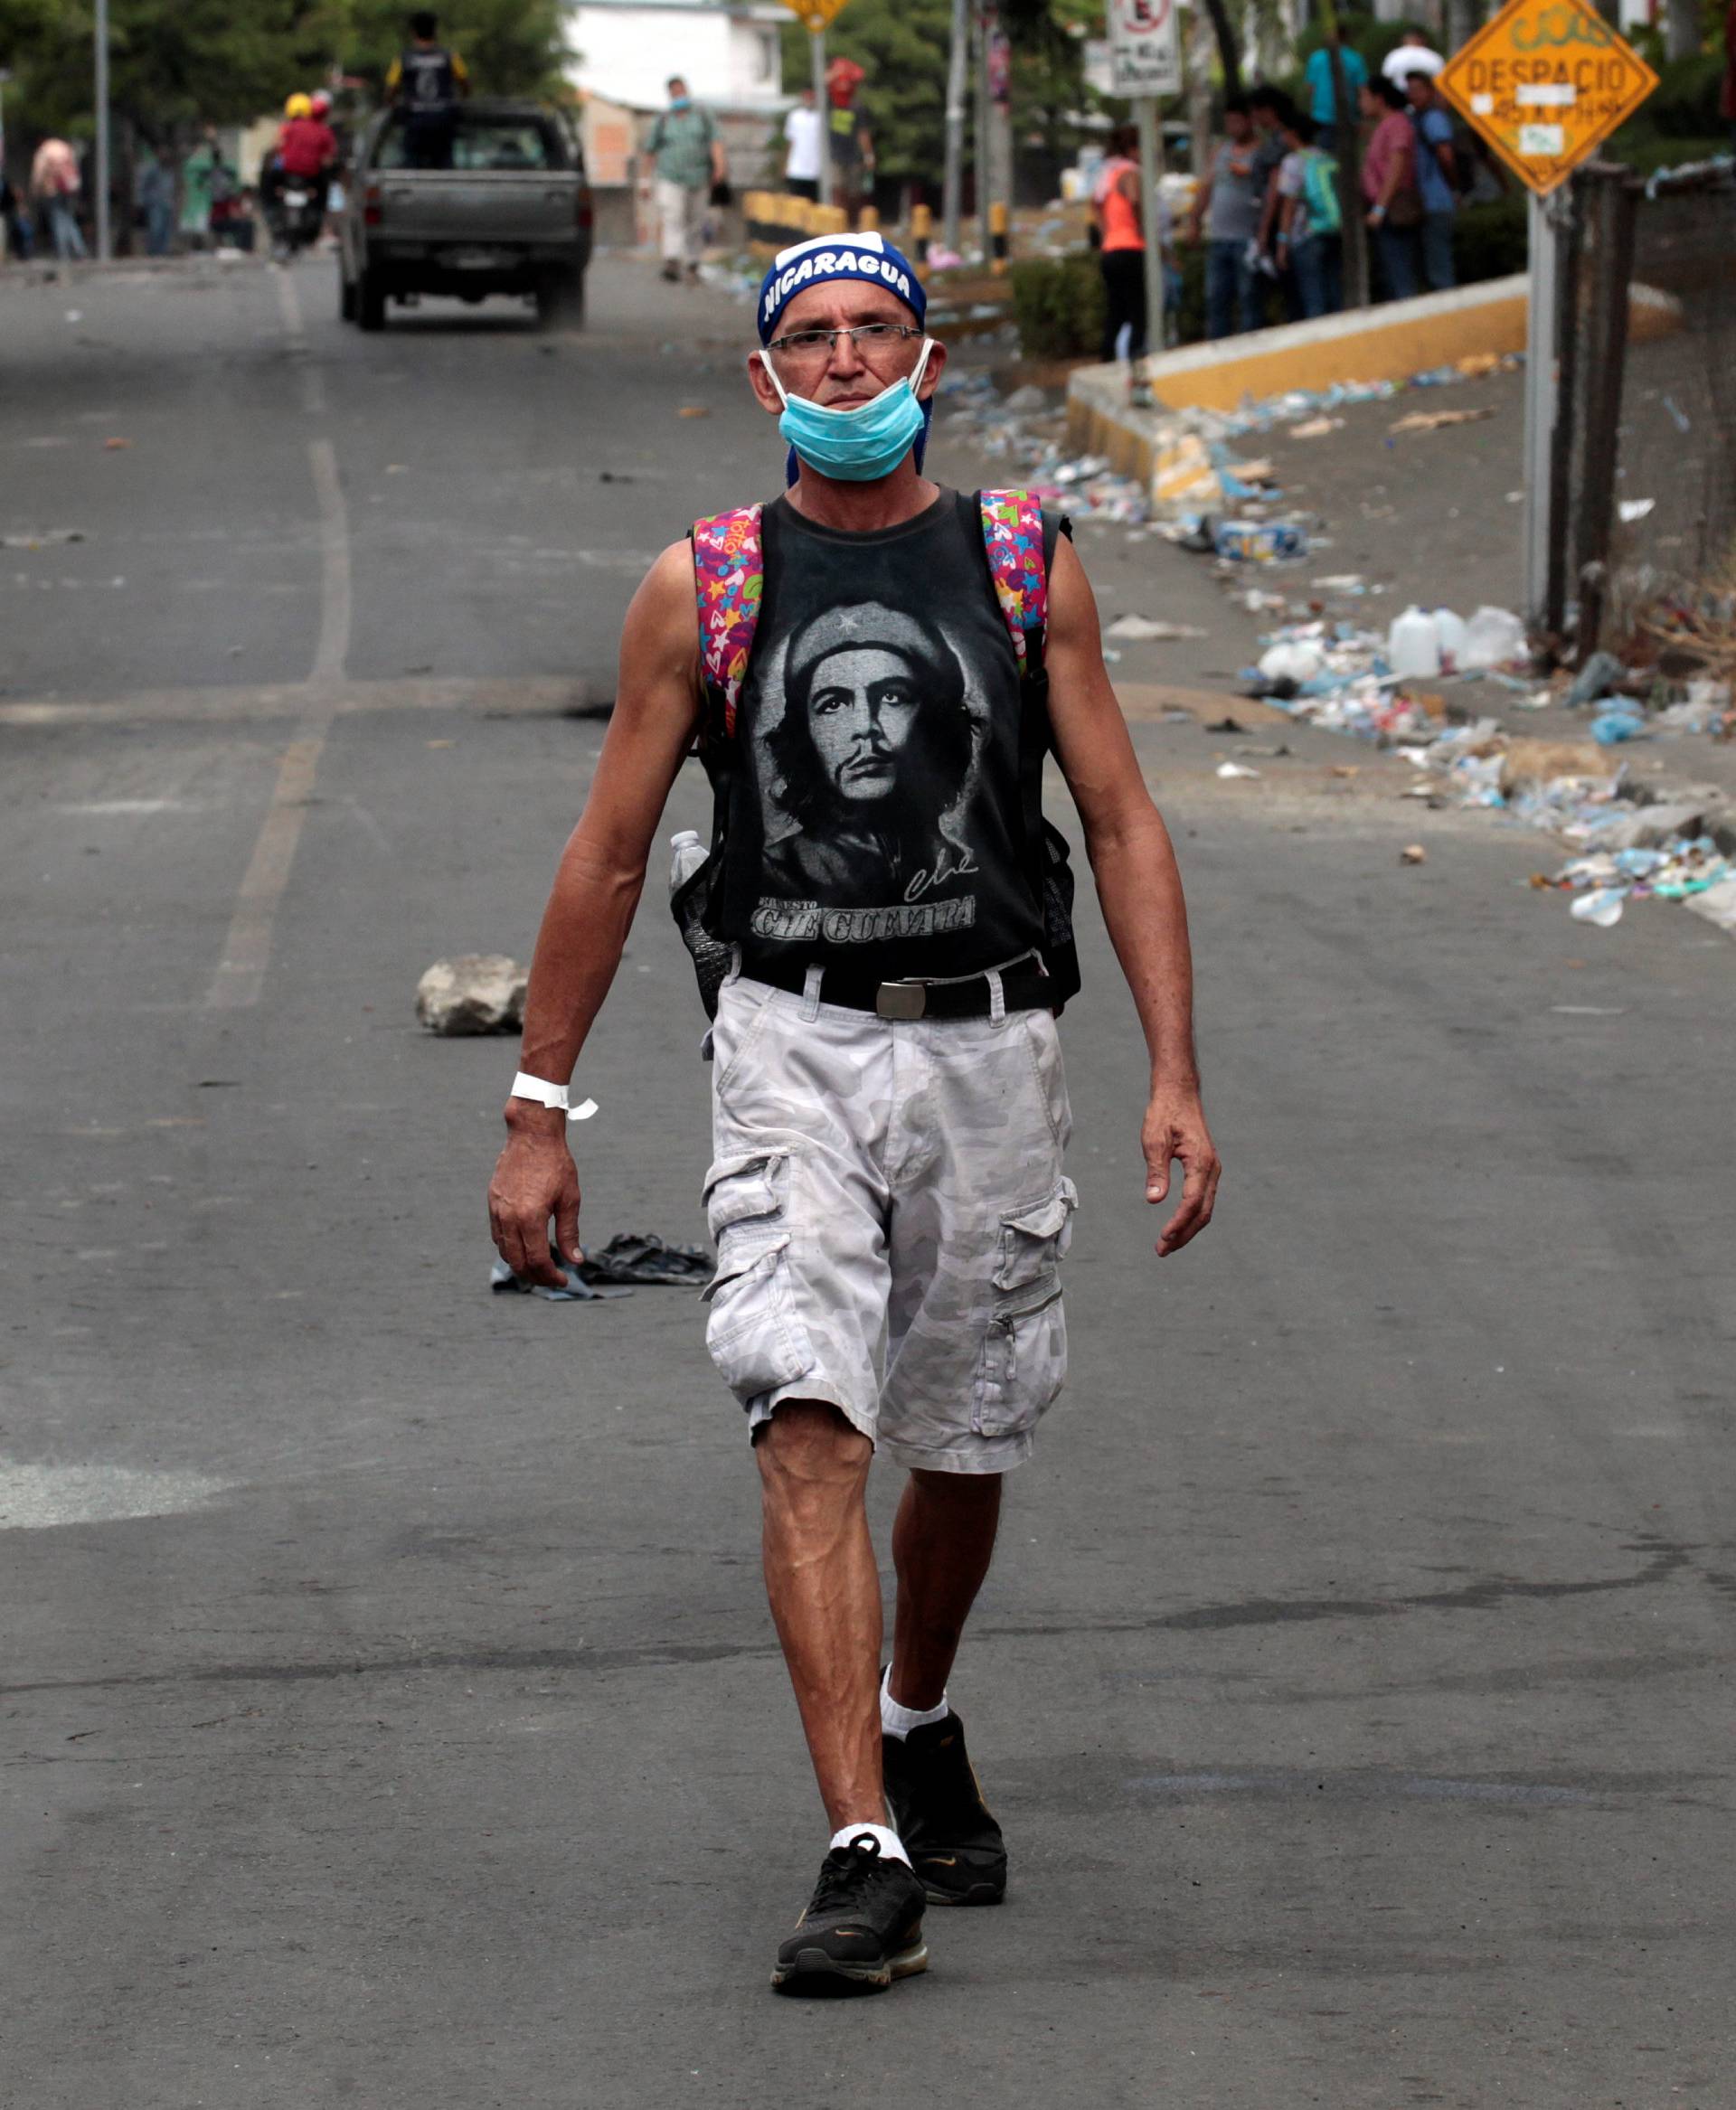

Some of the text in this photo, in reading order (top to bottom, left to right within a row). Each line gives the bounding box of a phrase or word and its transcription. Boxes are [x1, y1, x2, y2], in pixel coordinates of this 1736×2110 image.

[1467, 58, 1627, 94] DESPACIO
[764, 251, 910, 322] NICARAGUA
[823, 895, 976, 943] GUEVARA
